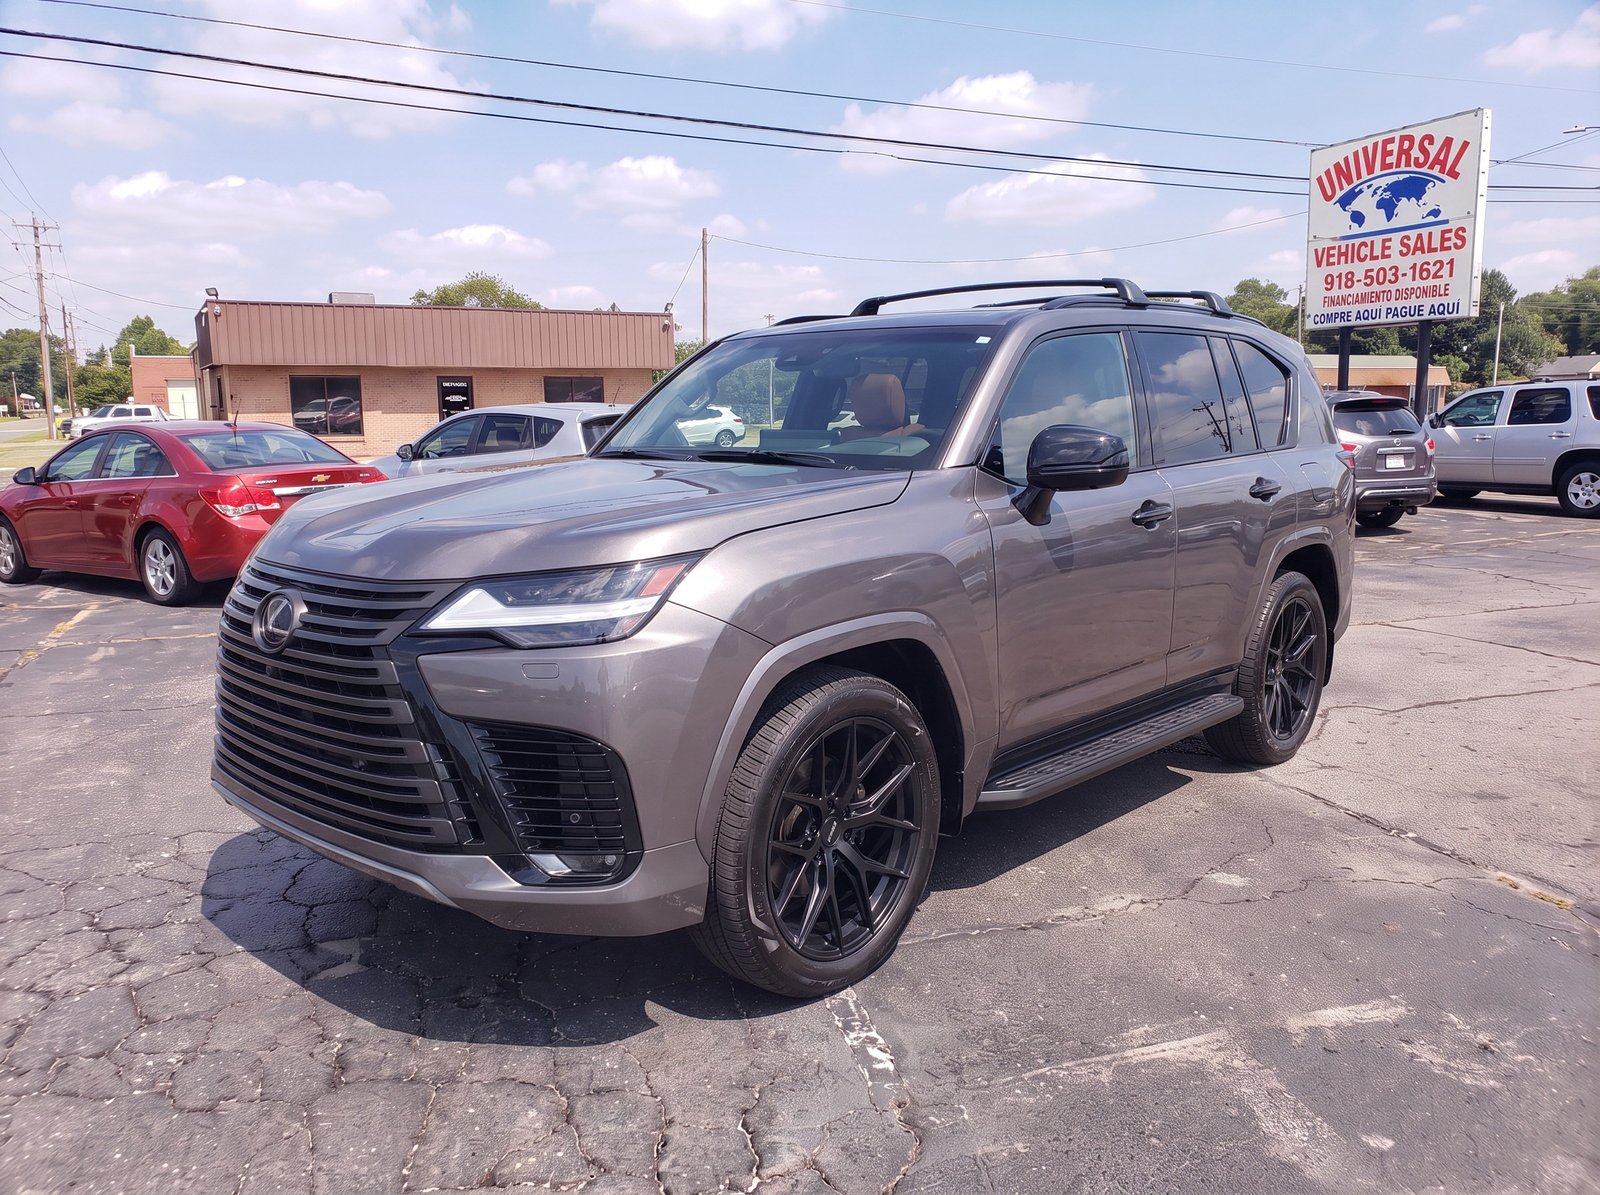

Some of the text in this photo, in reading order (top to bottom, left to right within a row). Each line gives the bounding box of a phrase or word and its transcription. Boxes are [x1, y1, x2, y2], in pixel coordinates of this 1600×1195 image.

[1316, 133, 1470, 202] UNIVERSAL
[1314, 226, 1467, 268] VEHICLE SALES
[1324, 258, 1454, 291] 918-503-1621
[1313, 299, 1460, 325] COMPRE AQUÍ PAGUE AQUÍ
[1323, 284, 1450, 308] FINANCIAMIENTO DISPONIBLE
